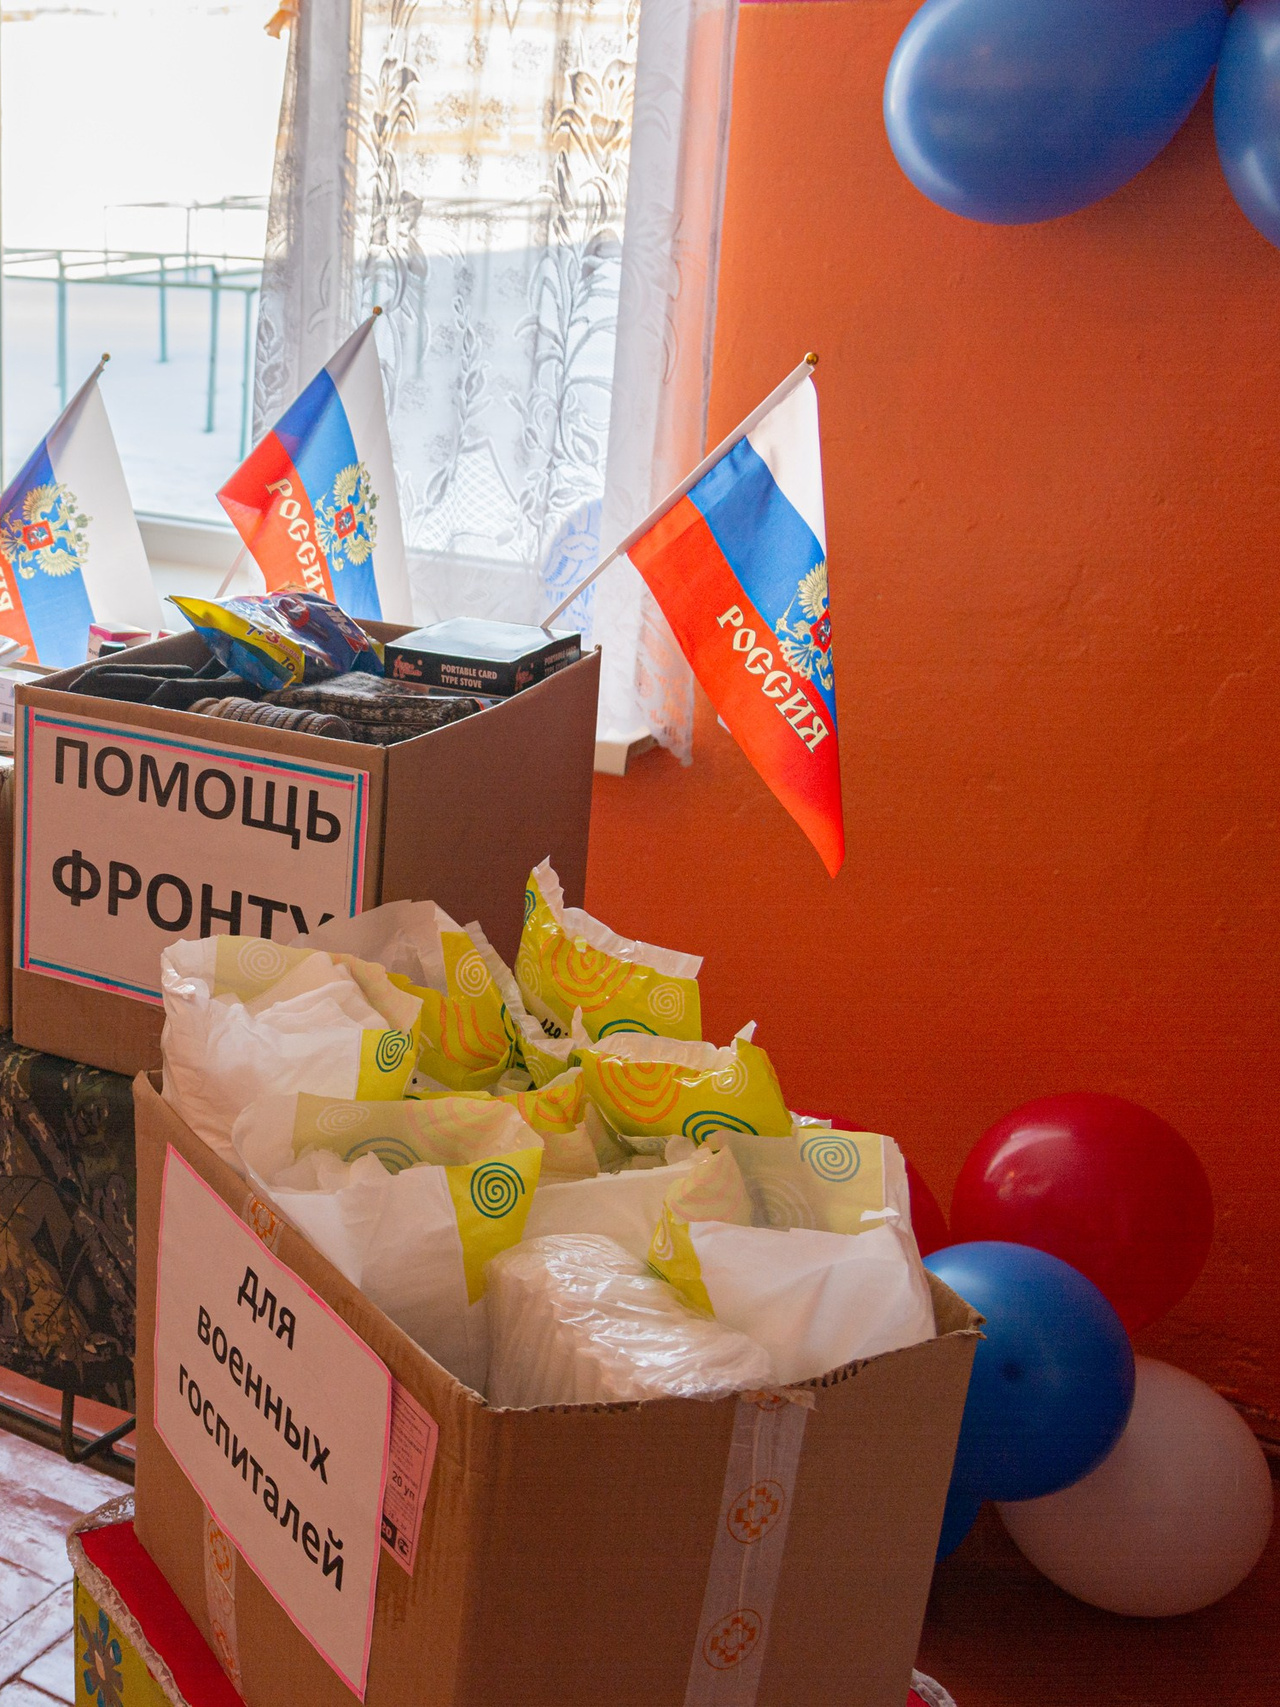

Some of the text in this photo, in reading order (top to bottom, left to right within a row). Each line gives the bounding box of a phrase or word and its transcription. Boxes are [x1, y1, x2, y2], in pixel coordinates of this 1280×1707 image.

[441, 664, 498, 681] PORTABLE CARD
[441, 674, 482, 689] TYPE STOVE
[716, 604, 830, 754] РОССИЯ
[55, 736, 341, 850] ПОМОЩЬ
[197, 1304, 331, 1485] военных
[179, 1362, 345, 1592] госпиталей
[391, 1470, 403, 1488] 20
[403, 1485, 416, 1501] уп
